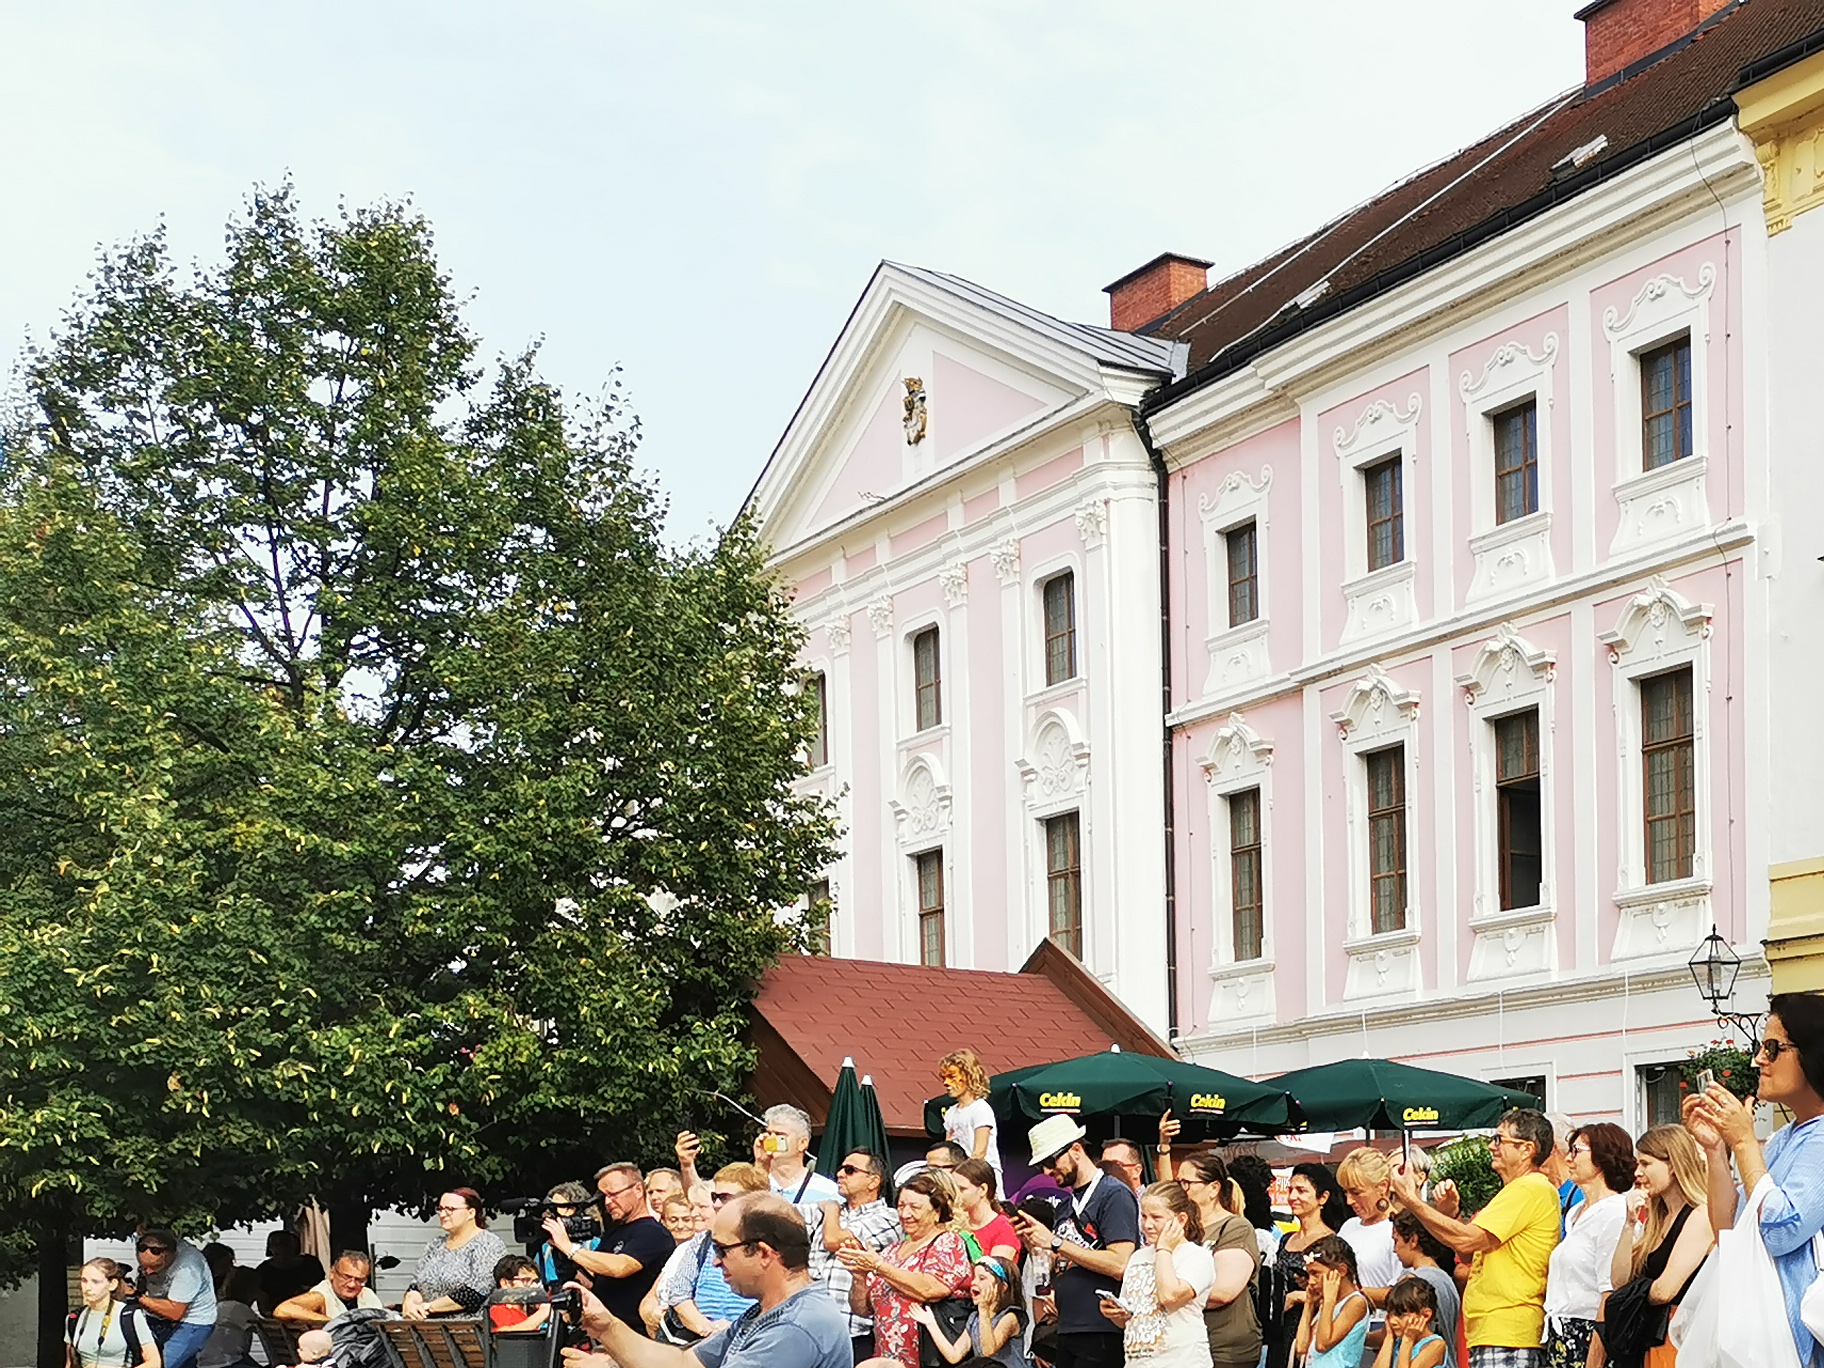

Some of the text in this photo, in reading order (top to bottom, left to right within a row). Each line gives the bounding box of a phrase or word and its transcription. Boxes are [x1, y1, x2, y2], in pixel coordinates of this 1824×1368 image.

[1039, 1092, 1082, 1108] Cekin
[1190, 1094, 1227, 1109] Cekin
[1402, 1107, 1439, 1121] Cekin
